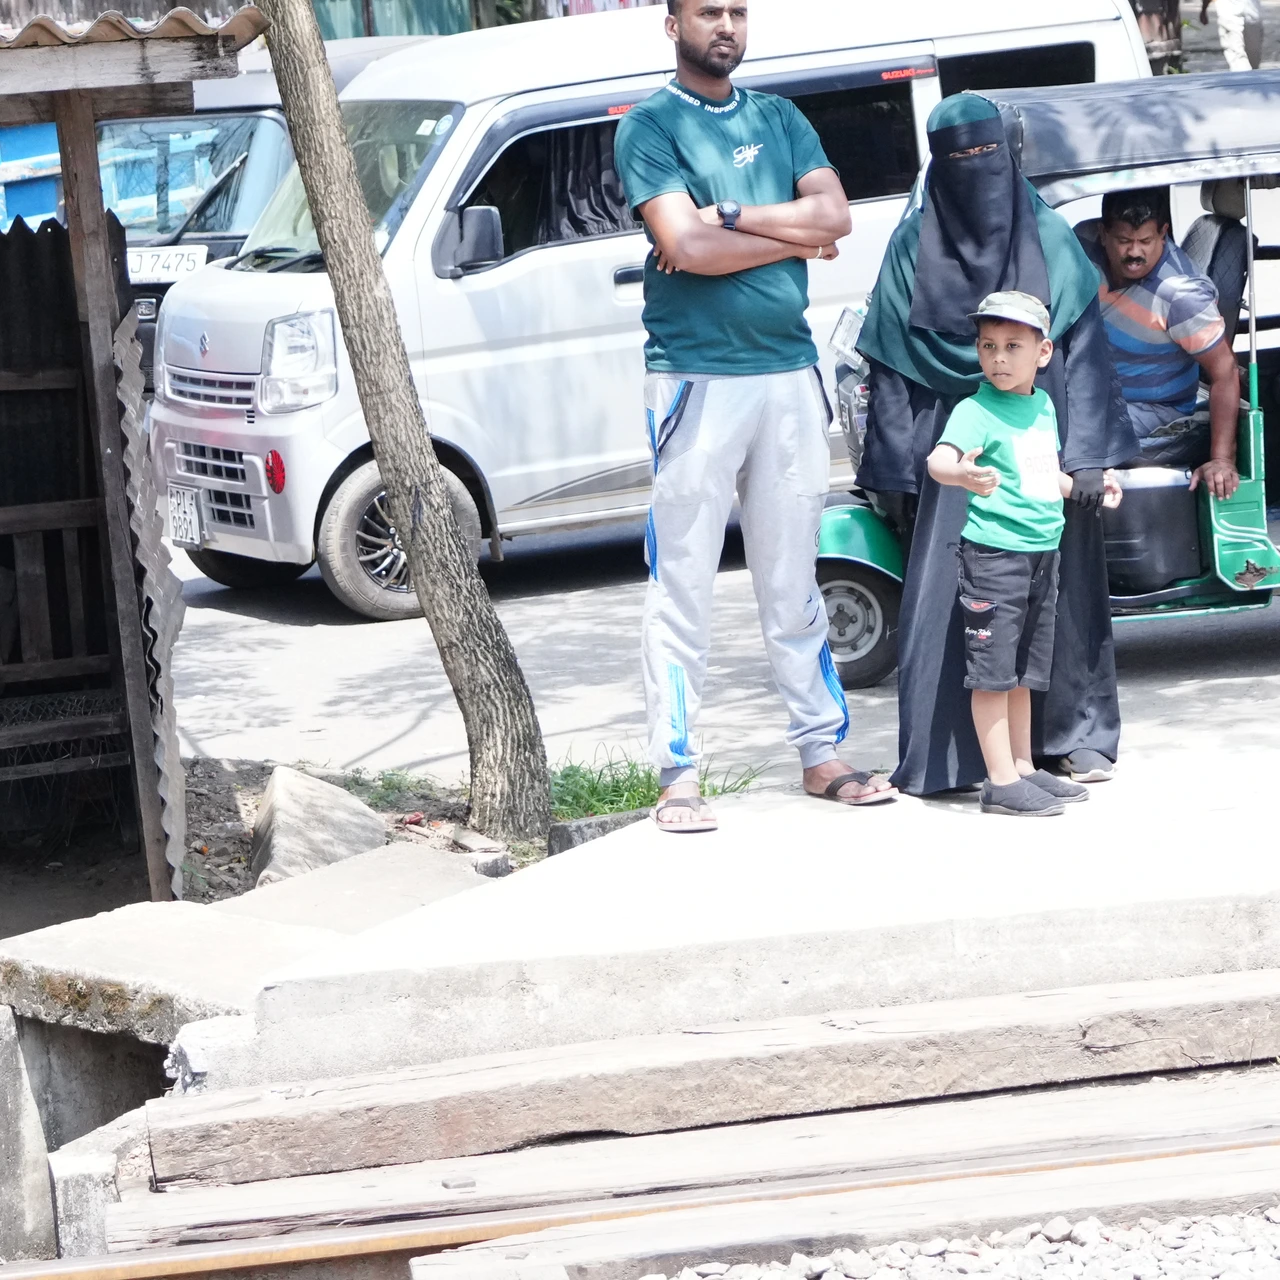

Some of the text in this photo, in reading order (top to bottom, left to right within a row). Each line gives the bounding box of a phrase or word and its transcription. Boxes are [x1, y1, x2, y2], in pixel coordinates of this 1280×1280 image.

[881, 68, 915, 80] SUZUKI
[705, 101, 738, 114] INSPIRED
[150, 252, 198, 273] 7475
[173, 515, 195, 540] 9891
